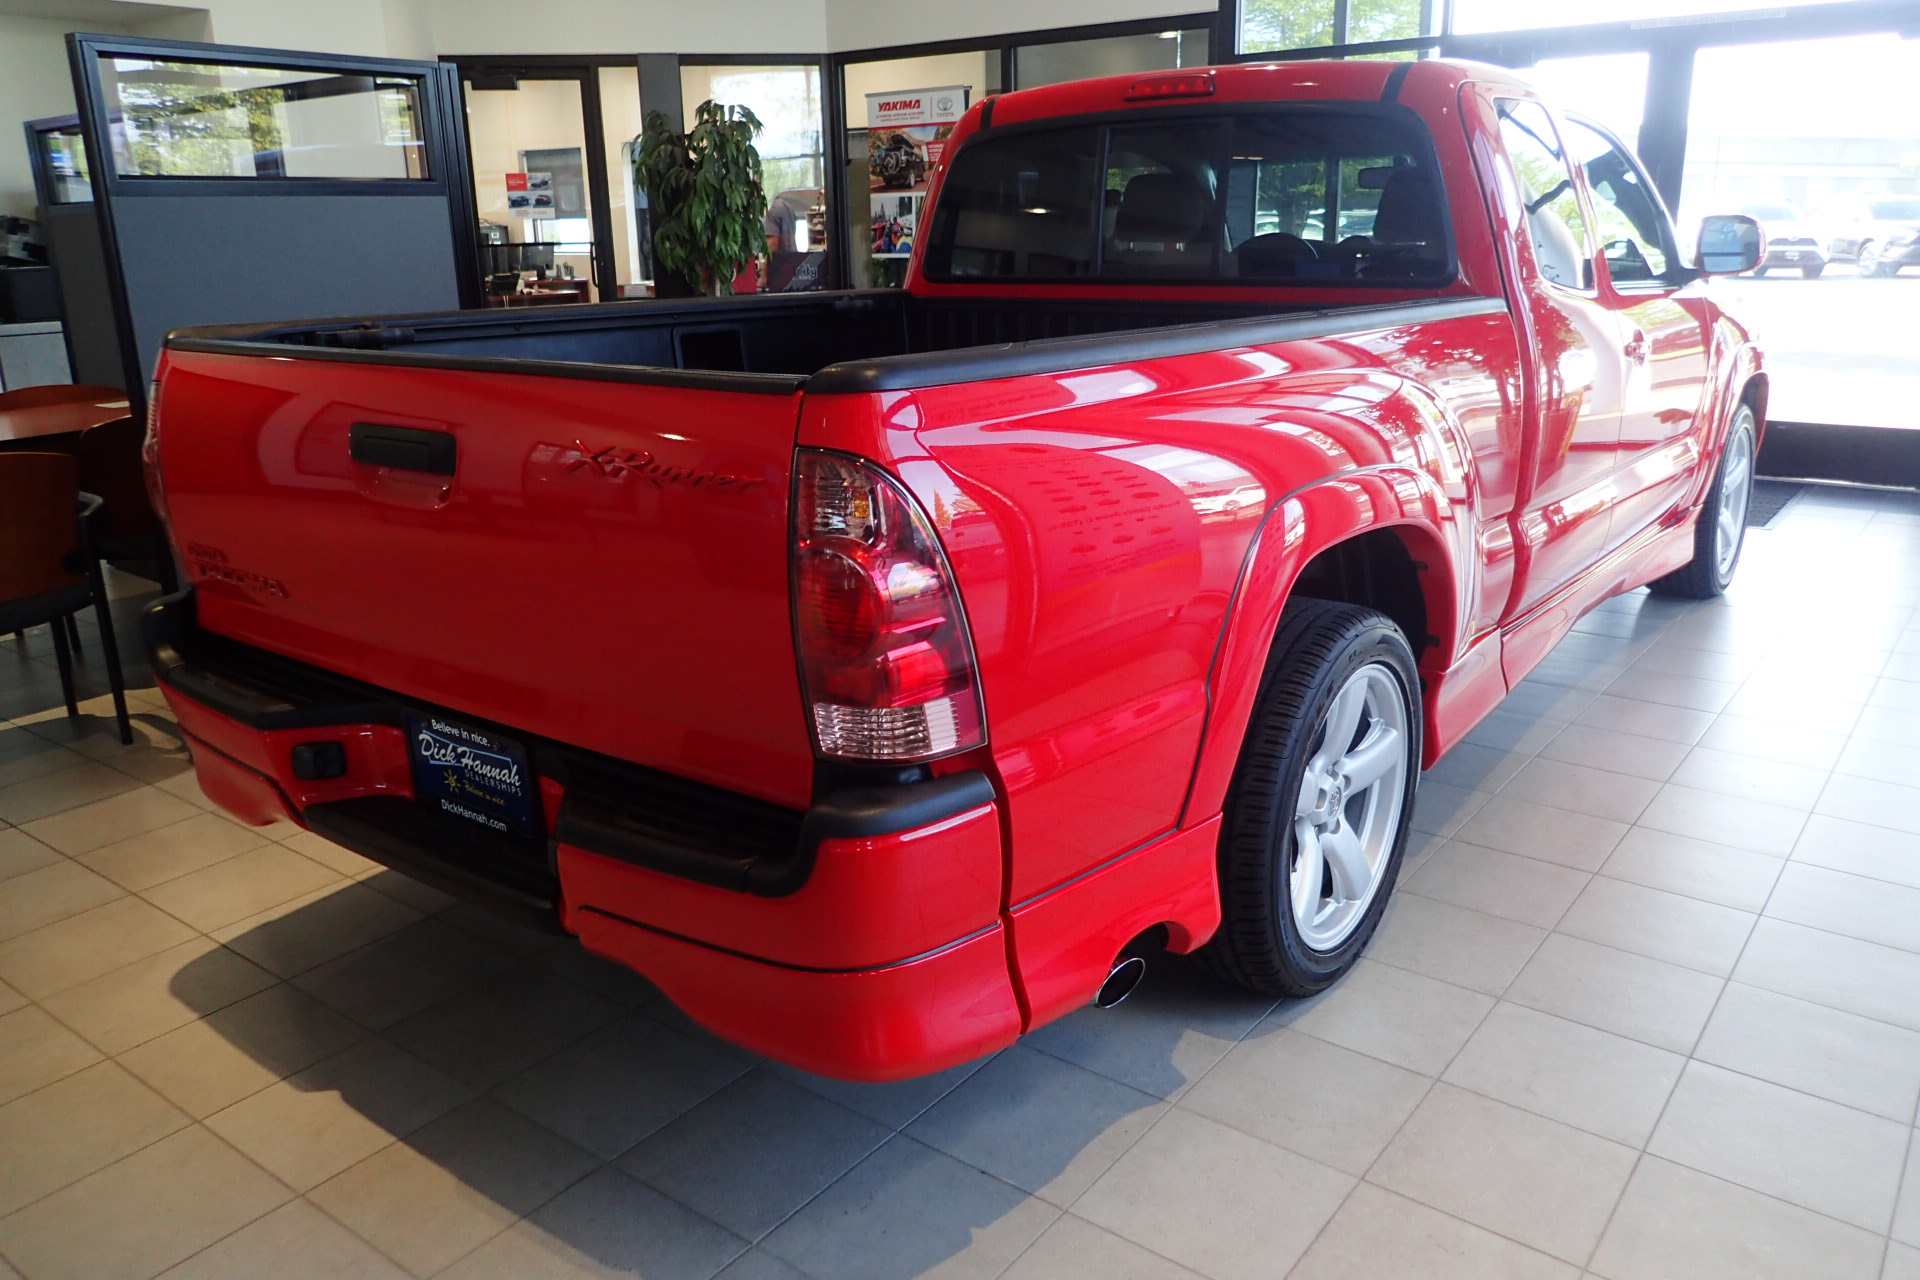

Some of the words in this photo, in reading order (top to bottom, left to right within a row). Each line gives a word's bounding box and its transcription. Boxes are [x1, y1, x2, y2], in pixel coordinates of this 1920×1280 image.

[878, 99, 921, 112] YAKIMA
[431, 719, 460, 737] Believe
[460, 728, 470, 740] in
[471, 733, 491, 747] nice.
[418, 733, 457, 764] Dick
[457, 746, 522, 787] Hannah
[464, 769, 522, 797] DEALERSHIPS
[441, 799, 507, 832] DickHannah.com
